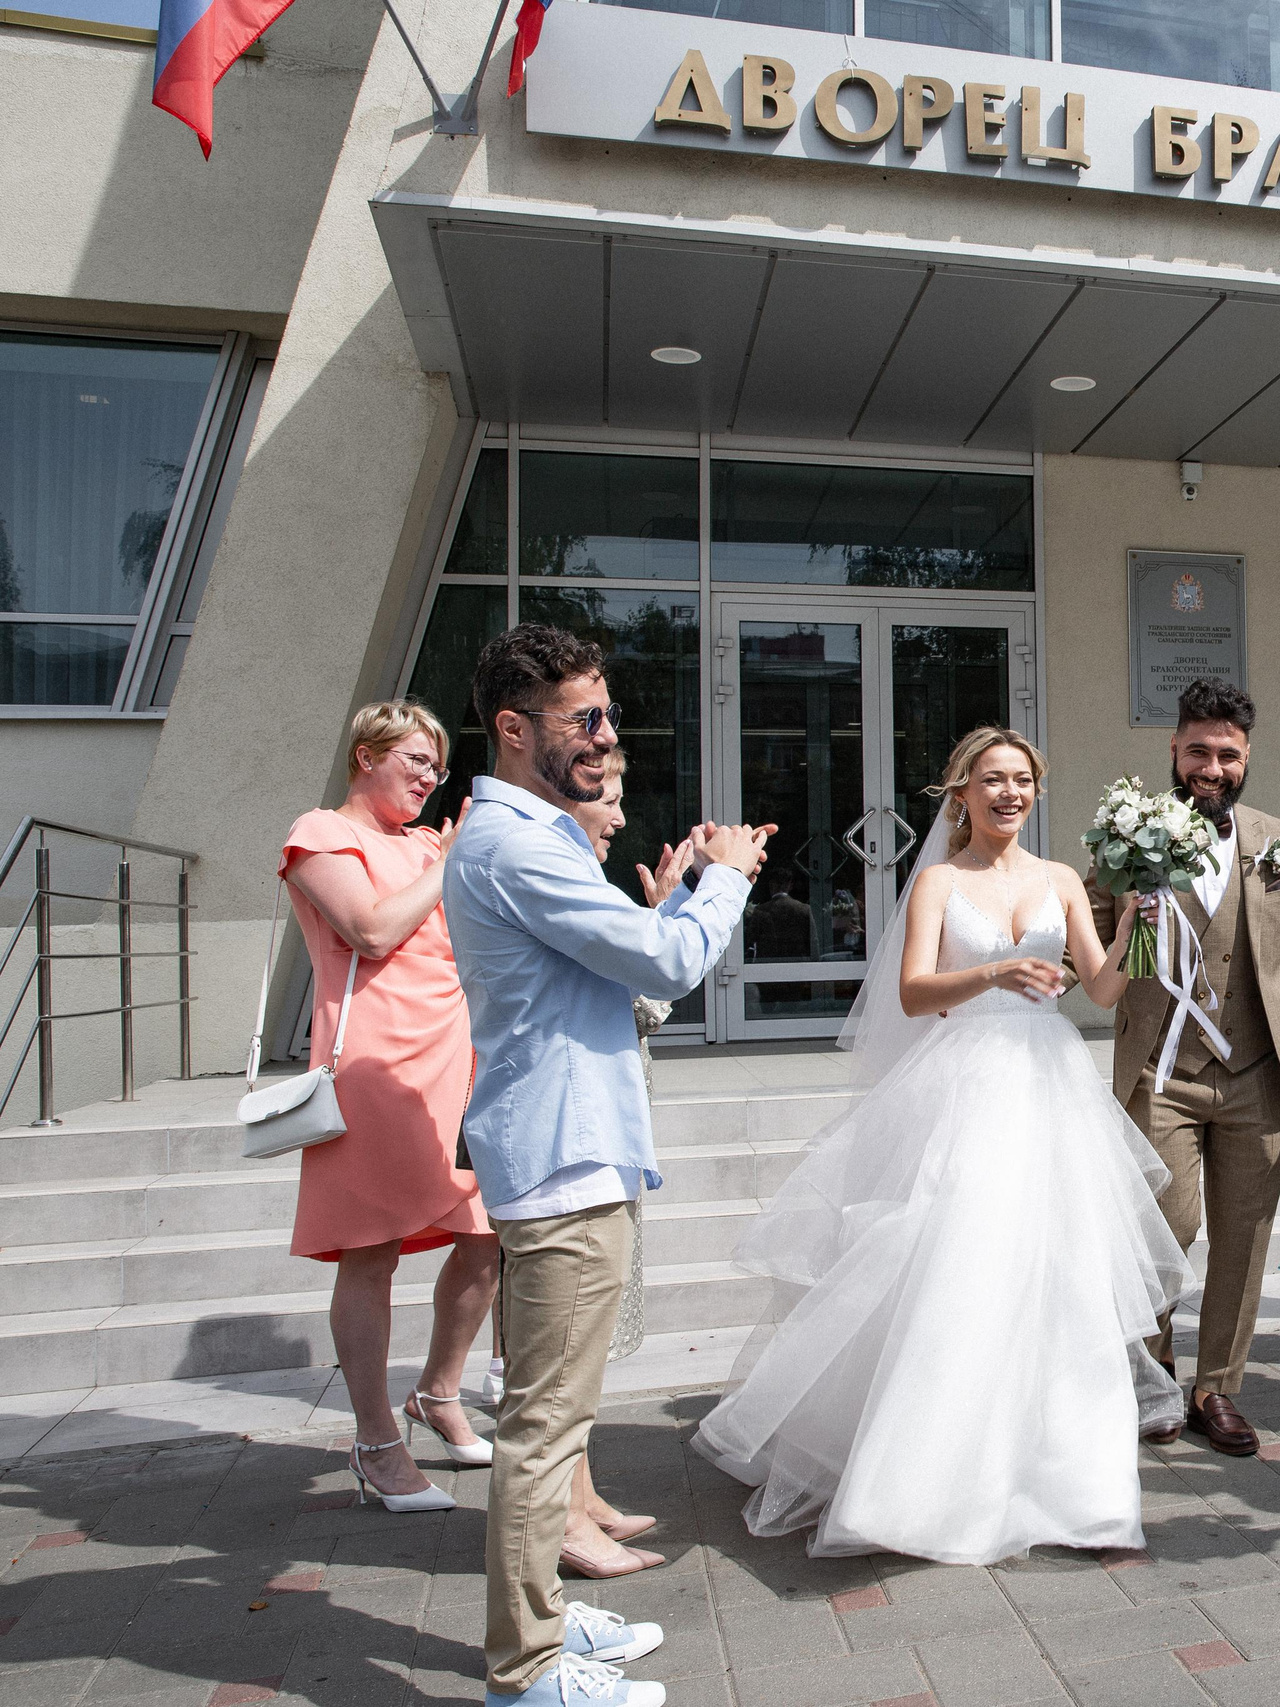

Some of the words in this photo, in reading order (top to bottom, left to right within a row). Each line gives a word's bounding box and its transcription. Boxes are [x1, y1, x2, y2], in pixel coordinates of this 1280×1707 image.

[654, 48, 1091, 169] ДВОРЕЦ
[1173, 656, 1208, 665] ДВОРЕЦ
[1150, 665, 1231, 674] БРАКОСОЧЕТАНИЯ
